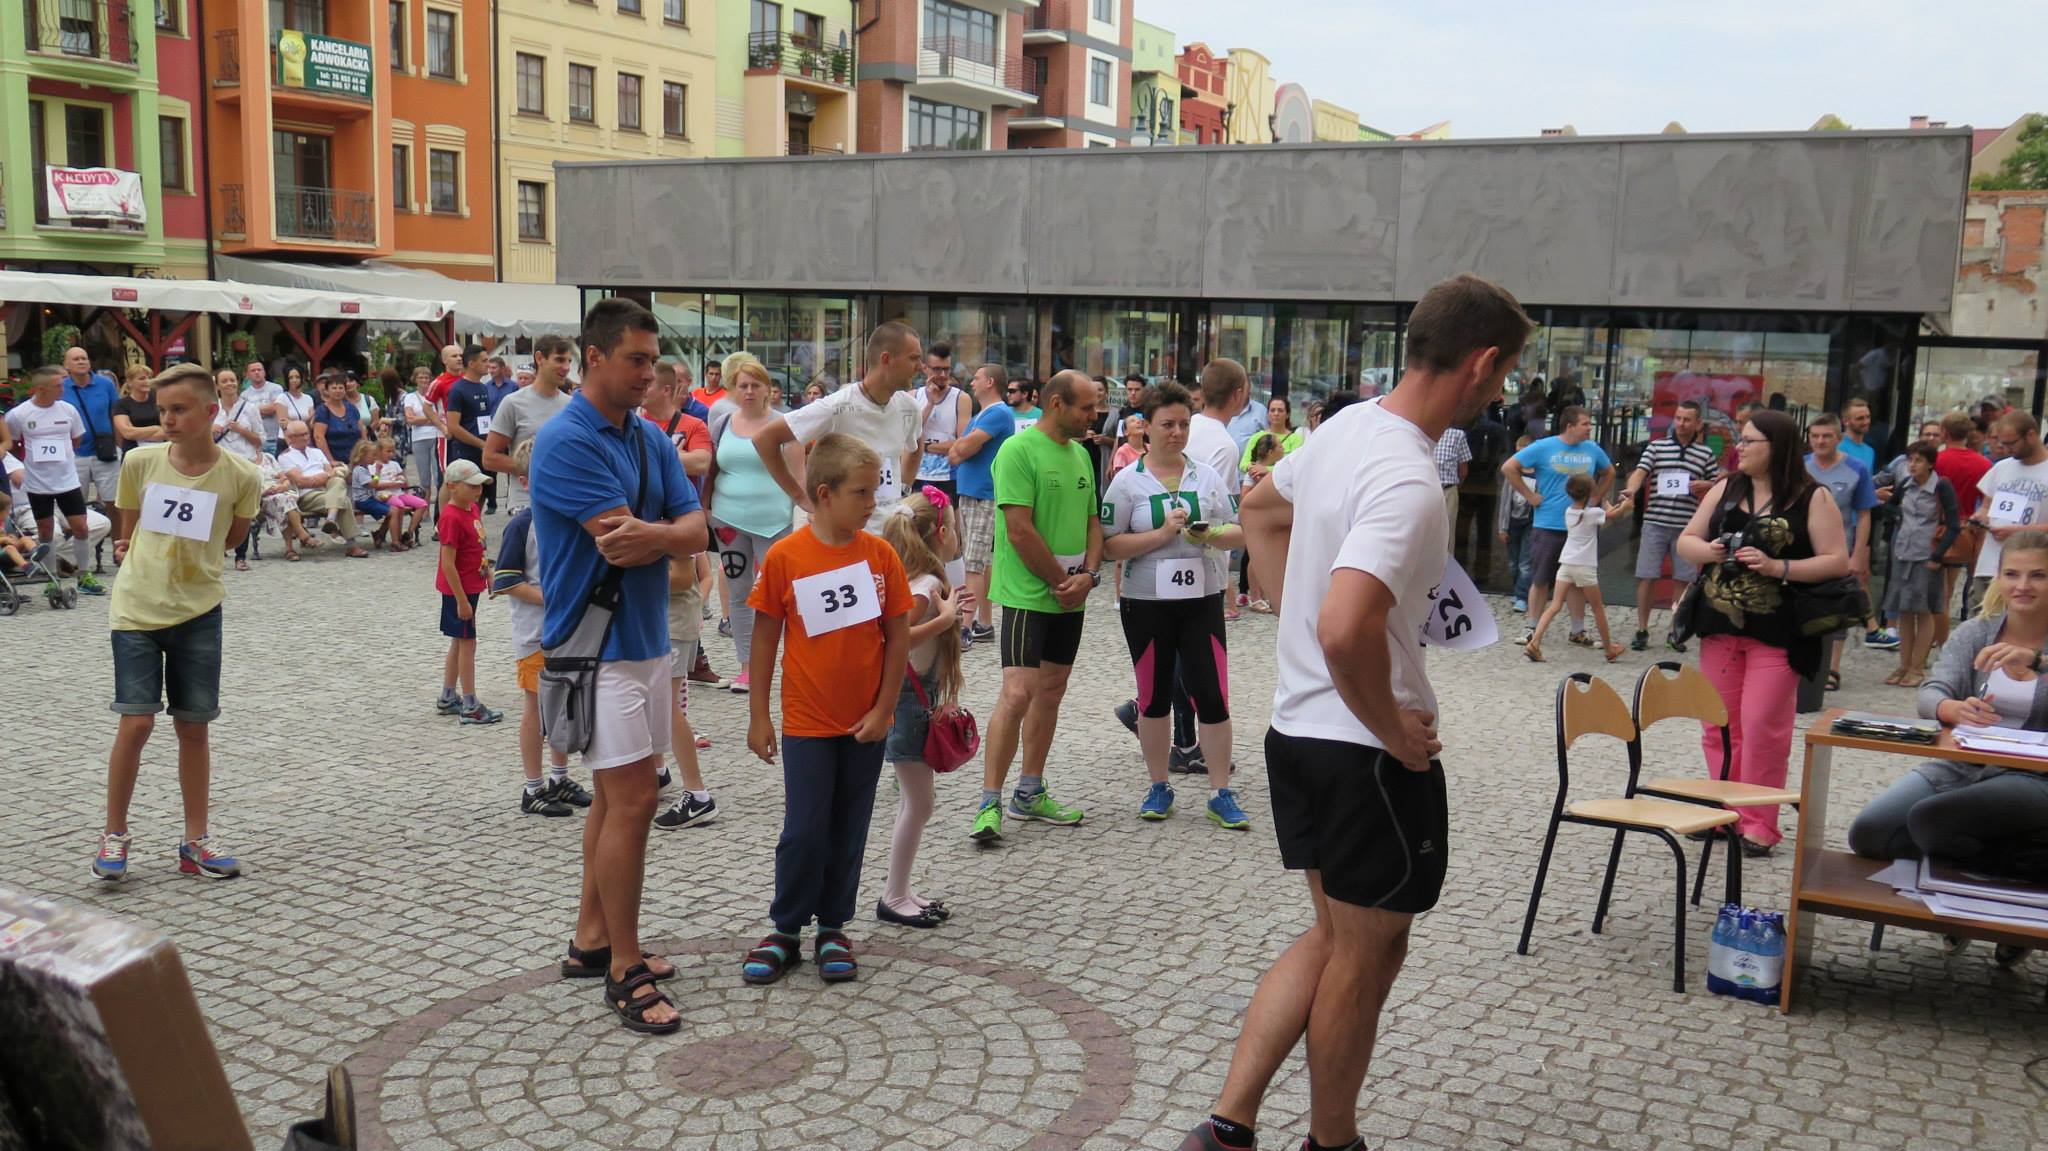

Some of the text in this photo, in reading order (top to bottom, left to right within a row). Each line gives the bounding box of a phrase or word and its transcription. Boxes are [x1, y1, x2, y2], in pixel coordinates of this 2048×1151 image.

[311, 39, 369, 60] KANCELARIA
[311, 51, 370, 72] ADWOKACKA
[41, 445, 57, 455] 70
[1666, 479, 1681, 489] 53
[163, 499, 194, 522] 78
[1999, 500, 2014, 512] 63
[1171, 569, 1195, 586] 48
[820, 583, 859, 613] 33
[1438, 587, 1472, 641] 52
